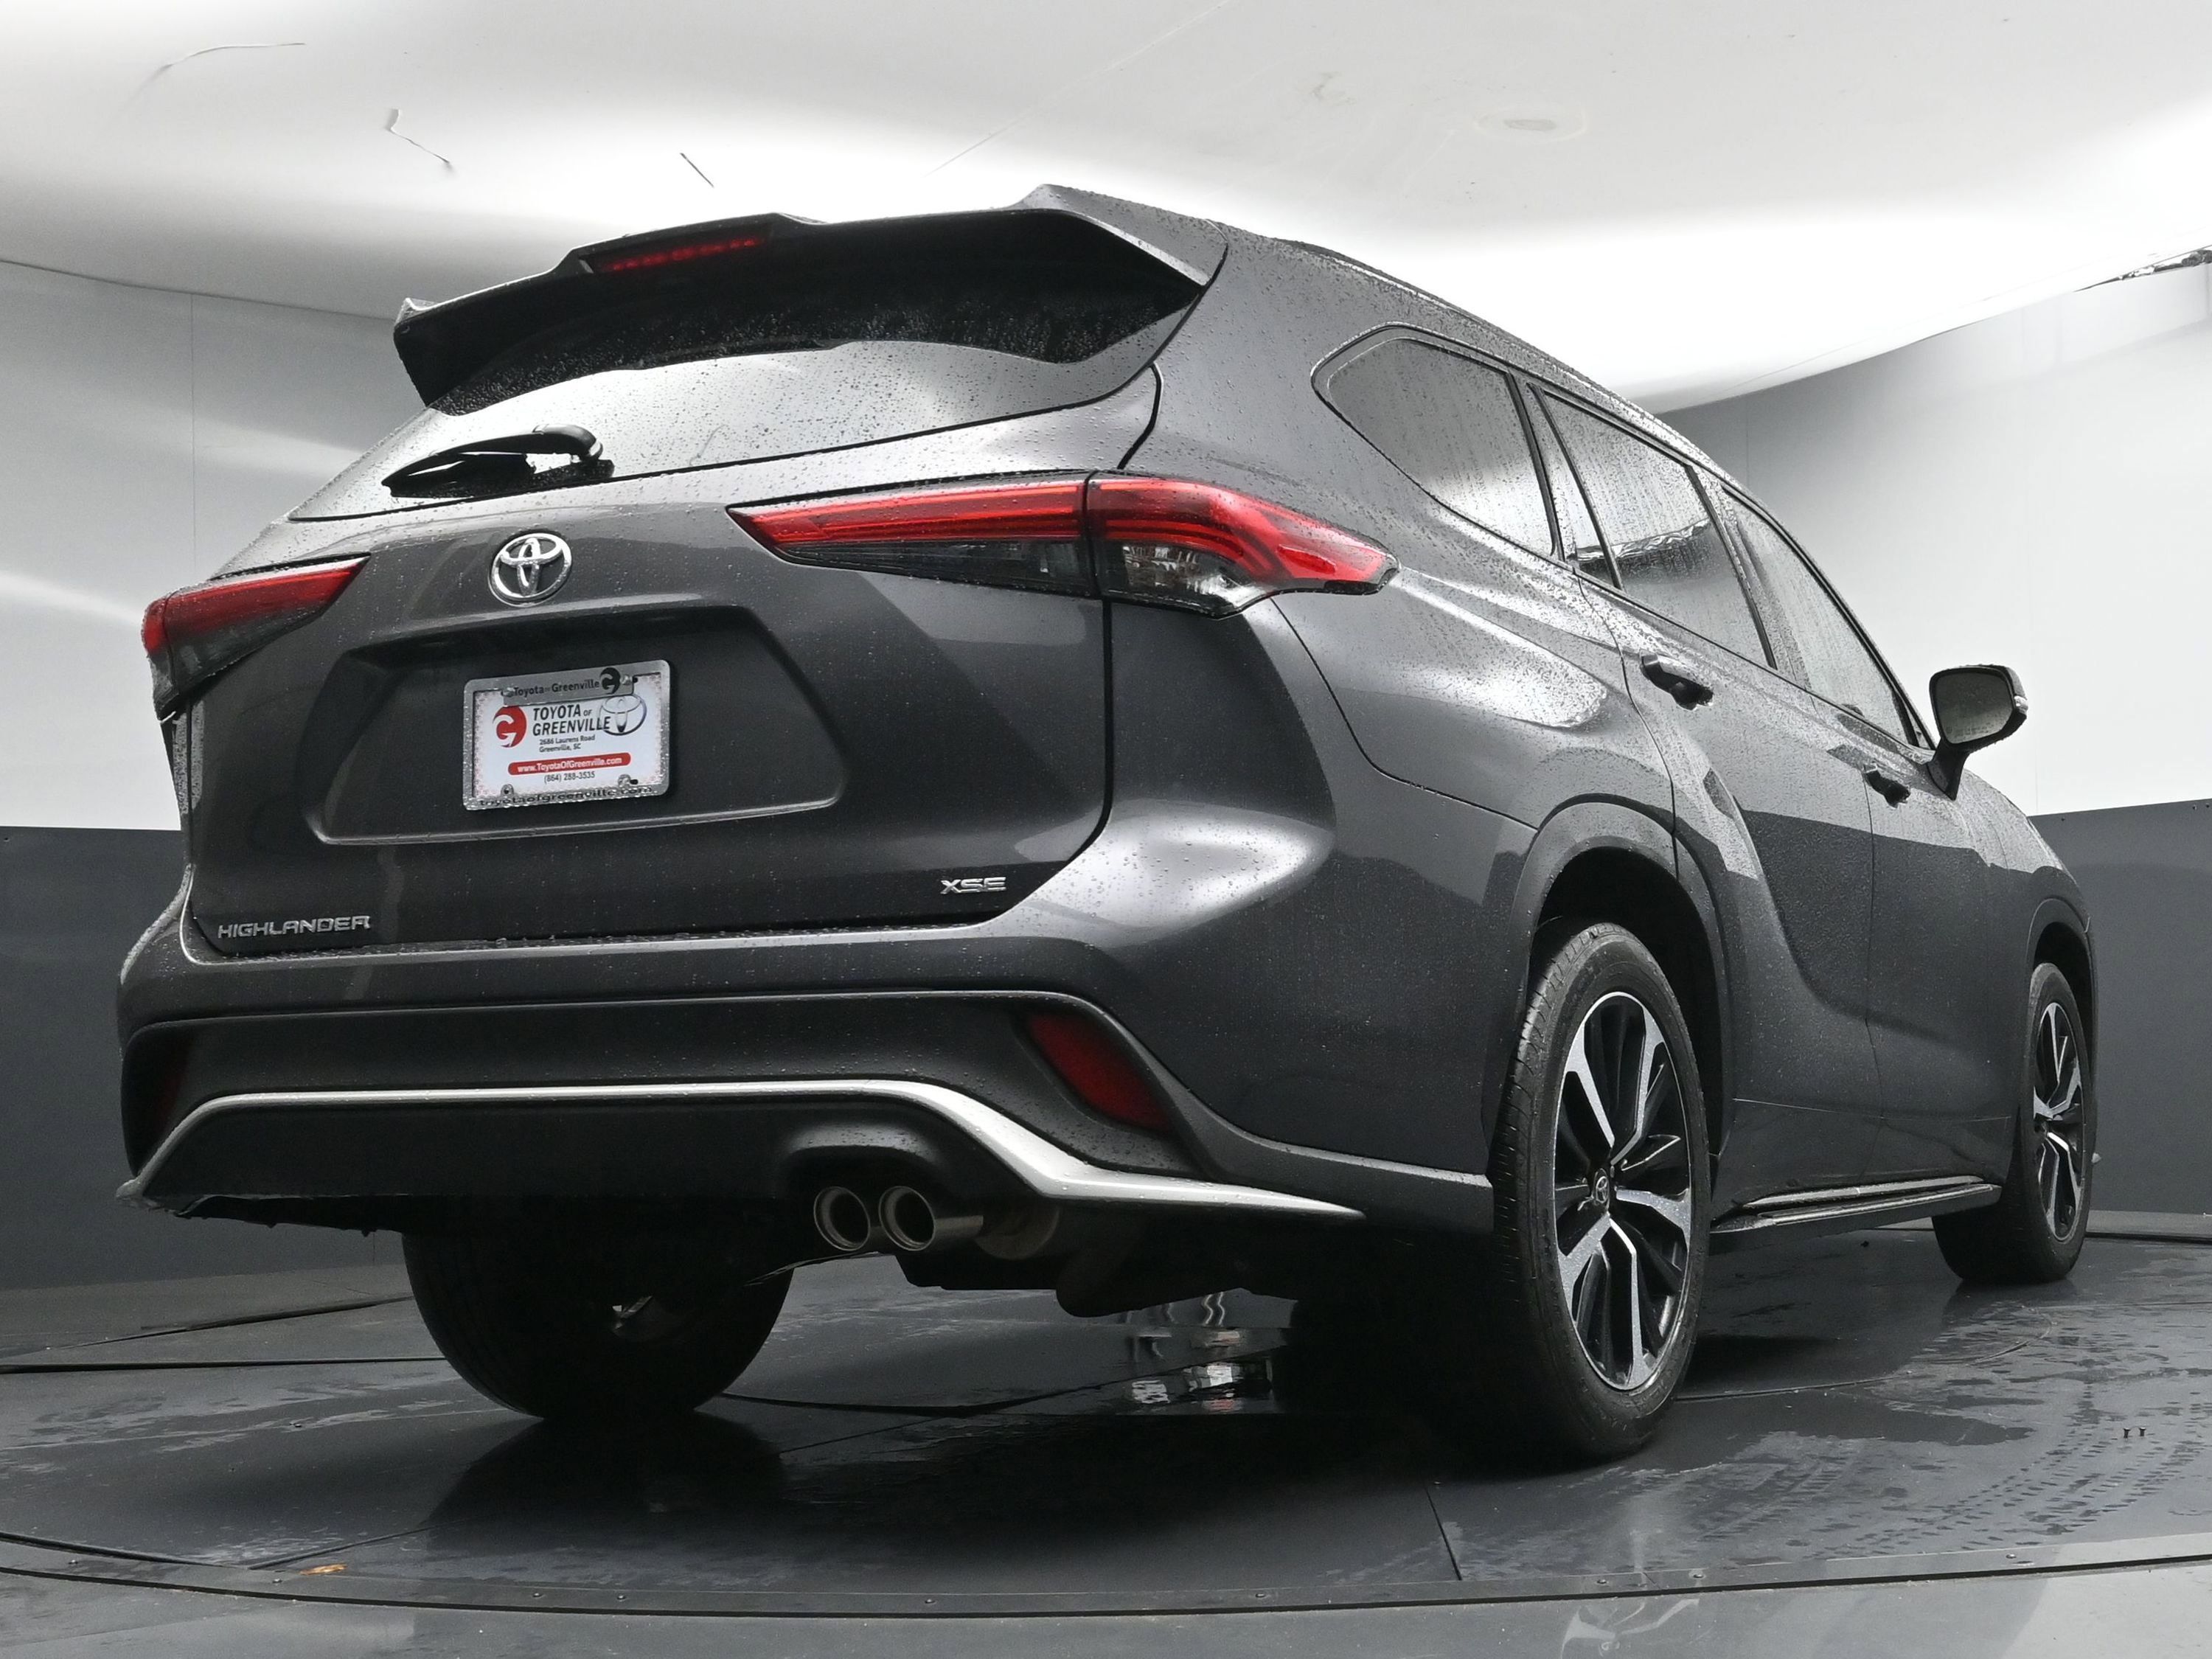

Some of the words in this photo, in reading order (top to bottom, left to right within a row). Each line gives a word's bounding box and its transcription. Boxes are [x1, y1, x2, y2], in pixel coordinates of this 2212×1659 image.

[514, 686, 544, 698] Toyota
[551, 678, 600, 692] Greenville
[533, 704, 581, 721] TOYOTA
[532, 716, 611, 737] GREENVILLE
[539, 745, 571, 753] Greenville,
[517, 757, 622, 773] www.ToyotaOfGreenville.com
[544, 773, 562, 784] (864)
[939, 876, 1006, 895] XSE
[218, 915, 371, 939] HIGHLANDER
